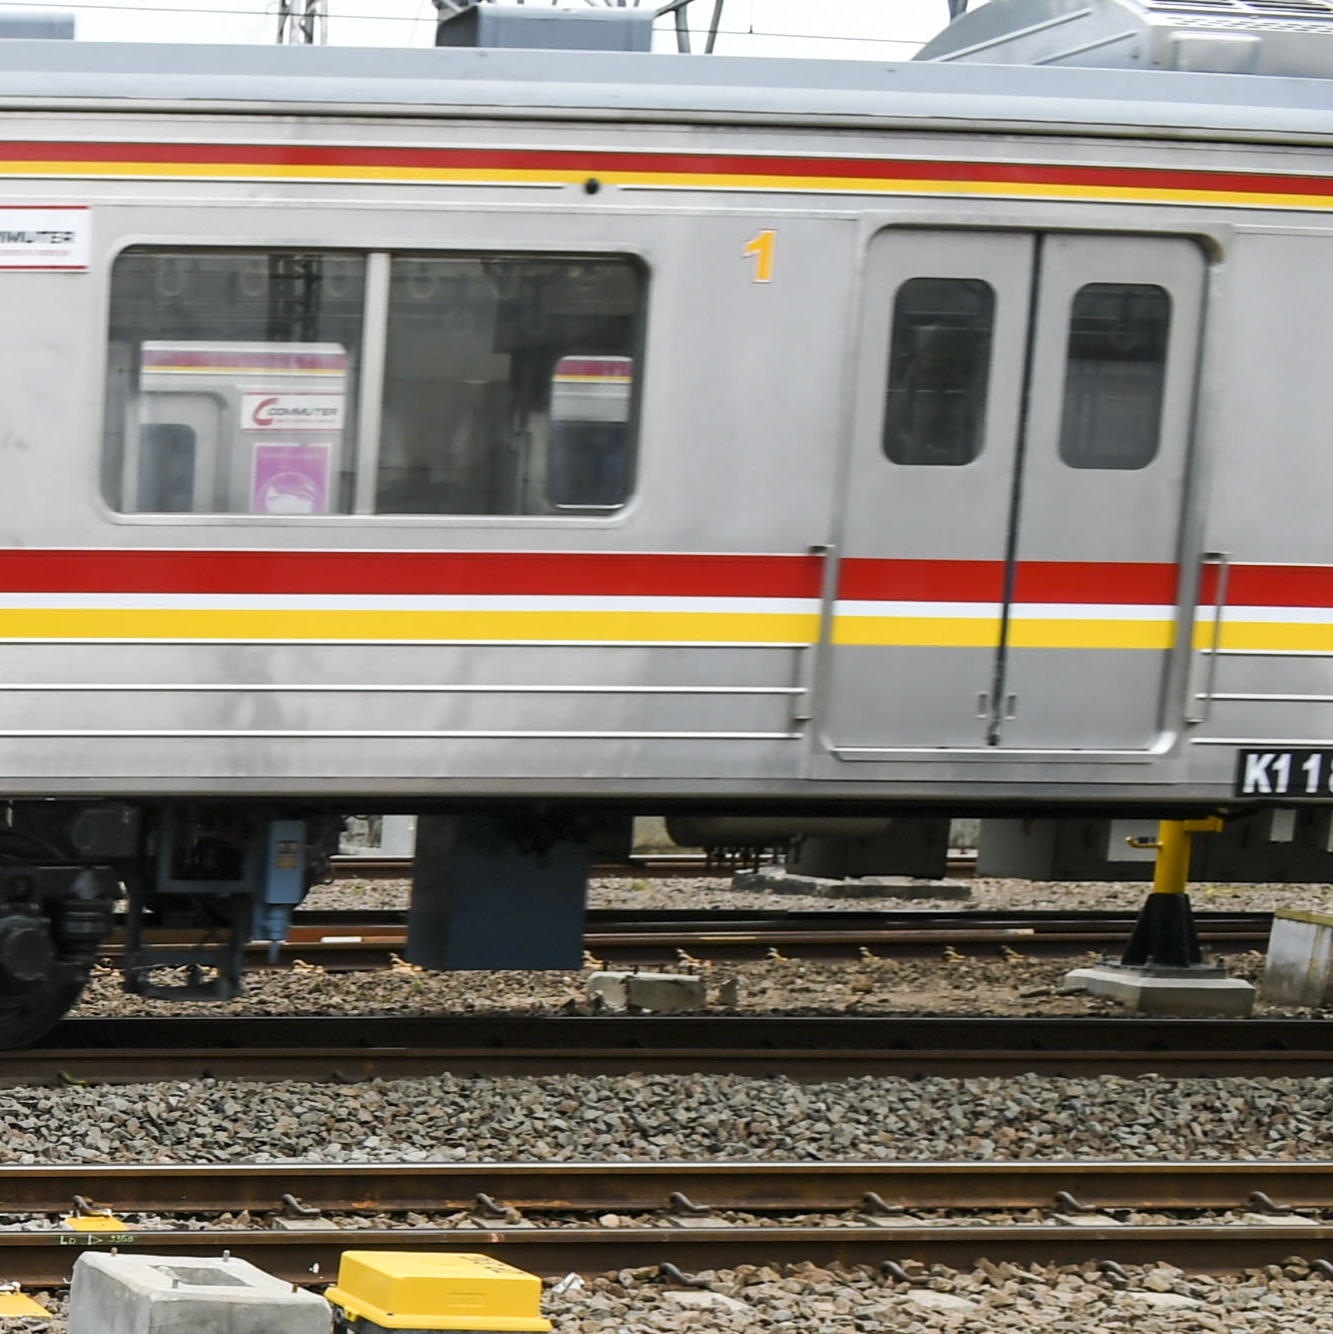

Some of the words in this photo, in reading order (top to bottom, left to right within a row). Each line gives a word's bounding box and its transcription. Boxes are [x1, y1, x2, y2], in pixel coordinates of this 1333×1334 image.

[741, 229, 777, 283] 1
[1242, 752, 1292, 793] K1
[1301, 752, 1322, 793] 1
